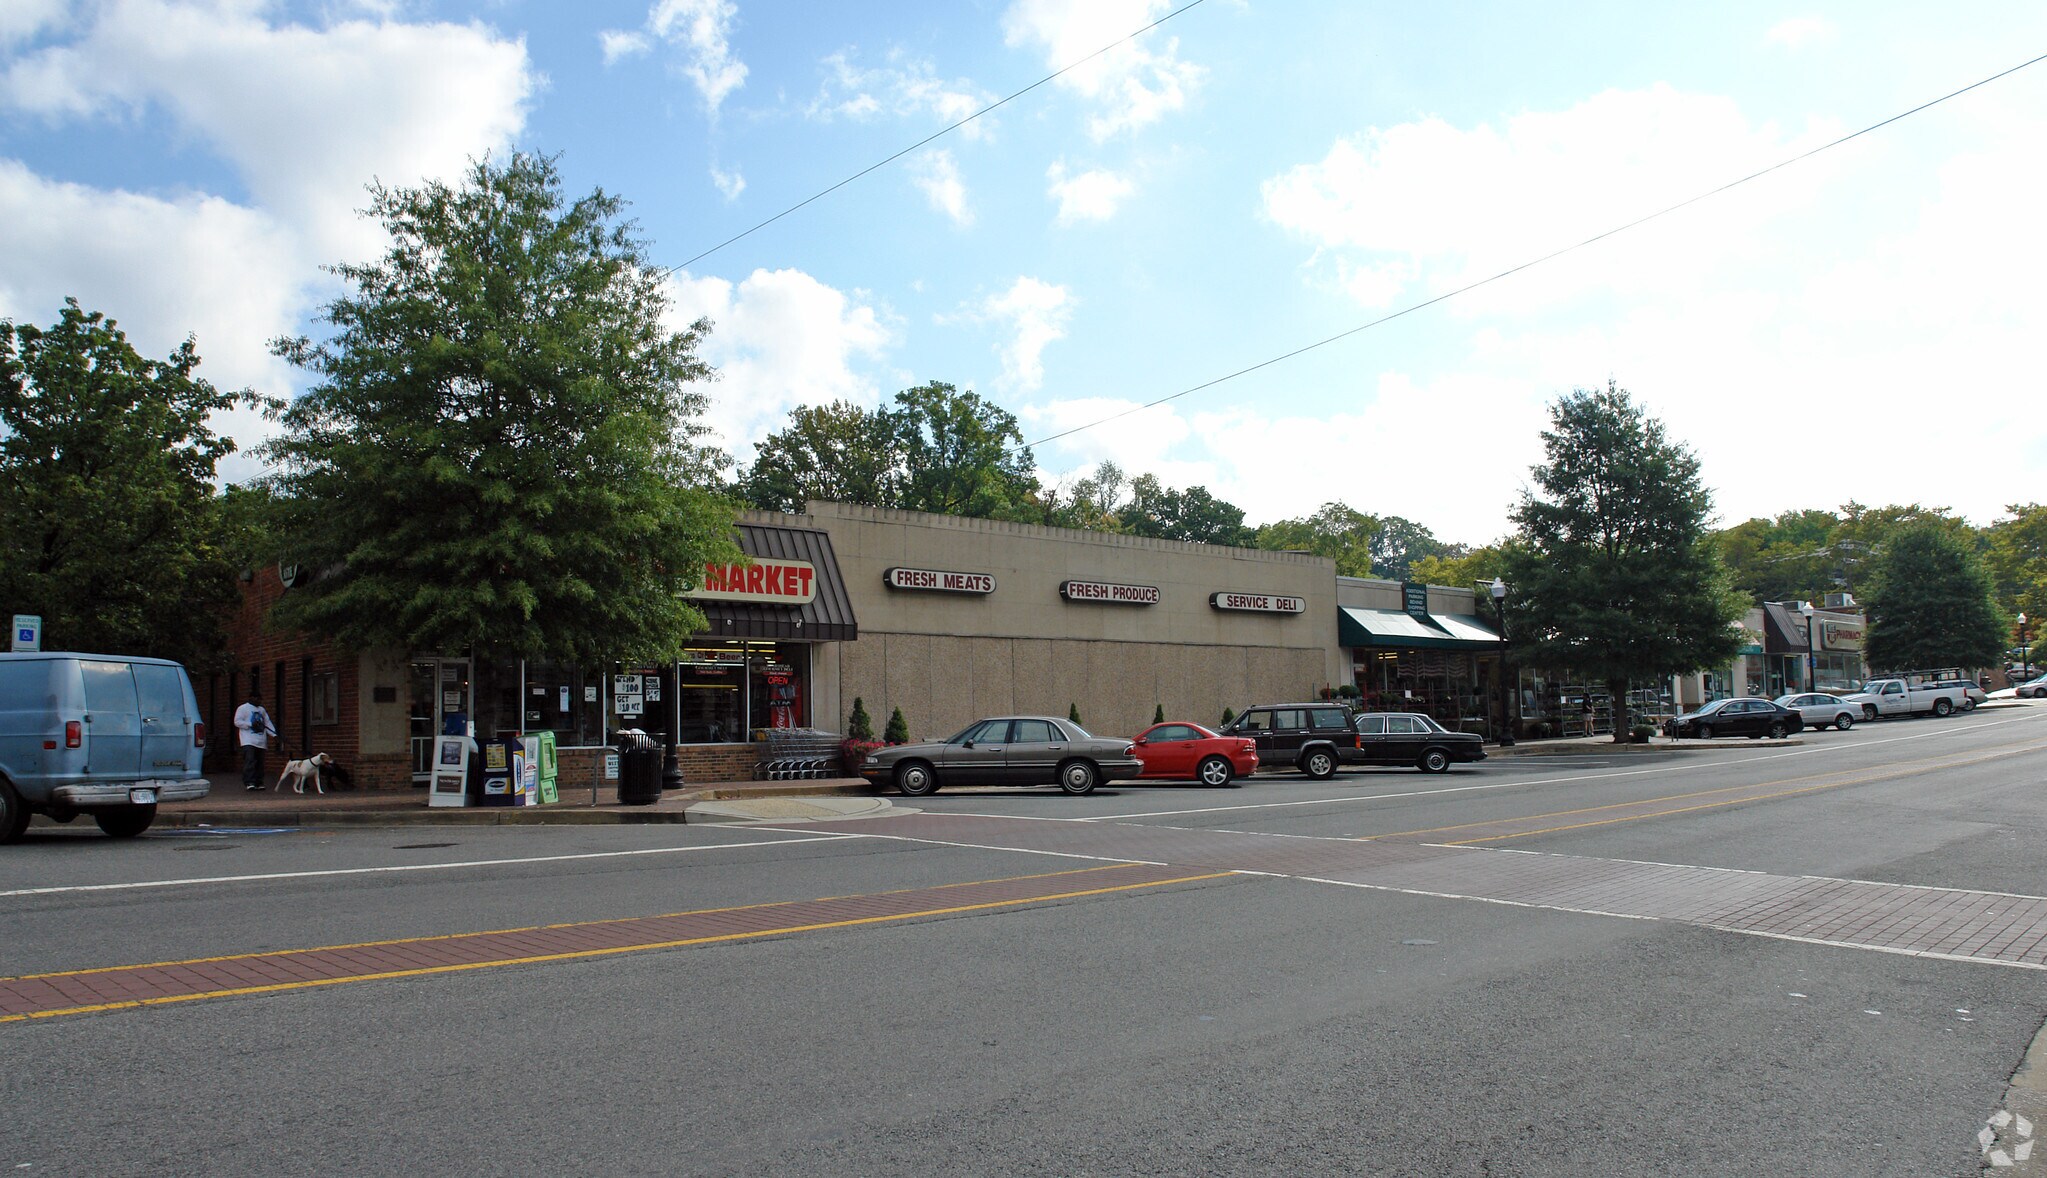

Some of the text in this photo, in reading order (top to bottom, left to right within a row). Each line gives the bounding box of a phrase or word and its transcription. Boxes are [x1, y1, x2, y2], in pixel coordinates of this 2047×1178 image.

[705, 563, 813, 597] MARKET
[897, 570, 991, 591] FRESH MEATS
[1069, 583, 1157, 602] FRESH PRODUCE
[1227, 595, 1296, 610] SERVICE DELI
[719, 652, 741, 661] Beer
[768, 676, 789, 685] OPEN
